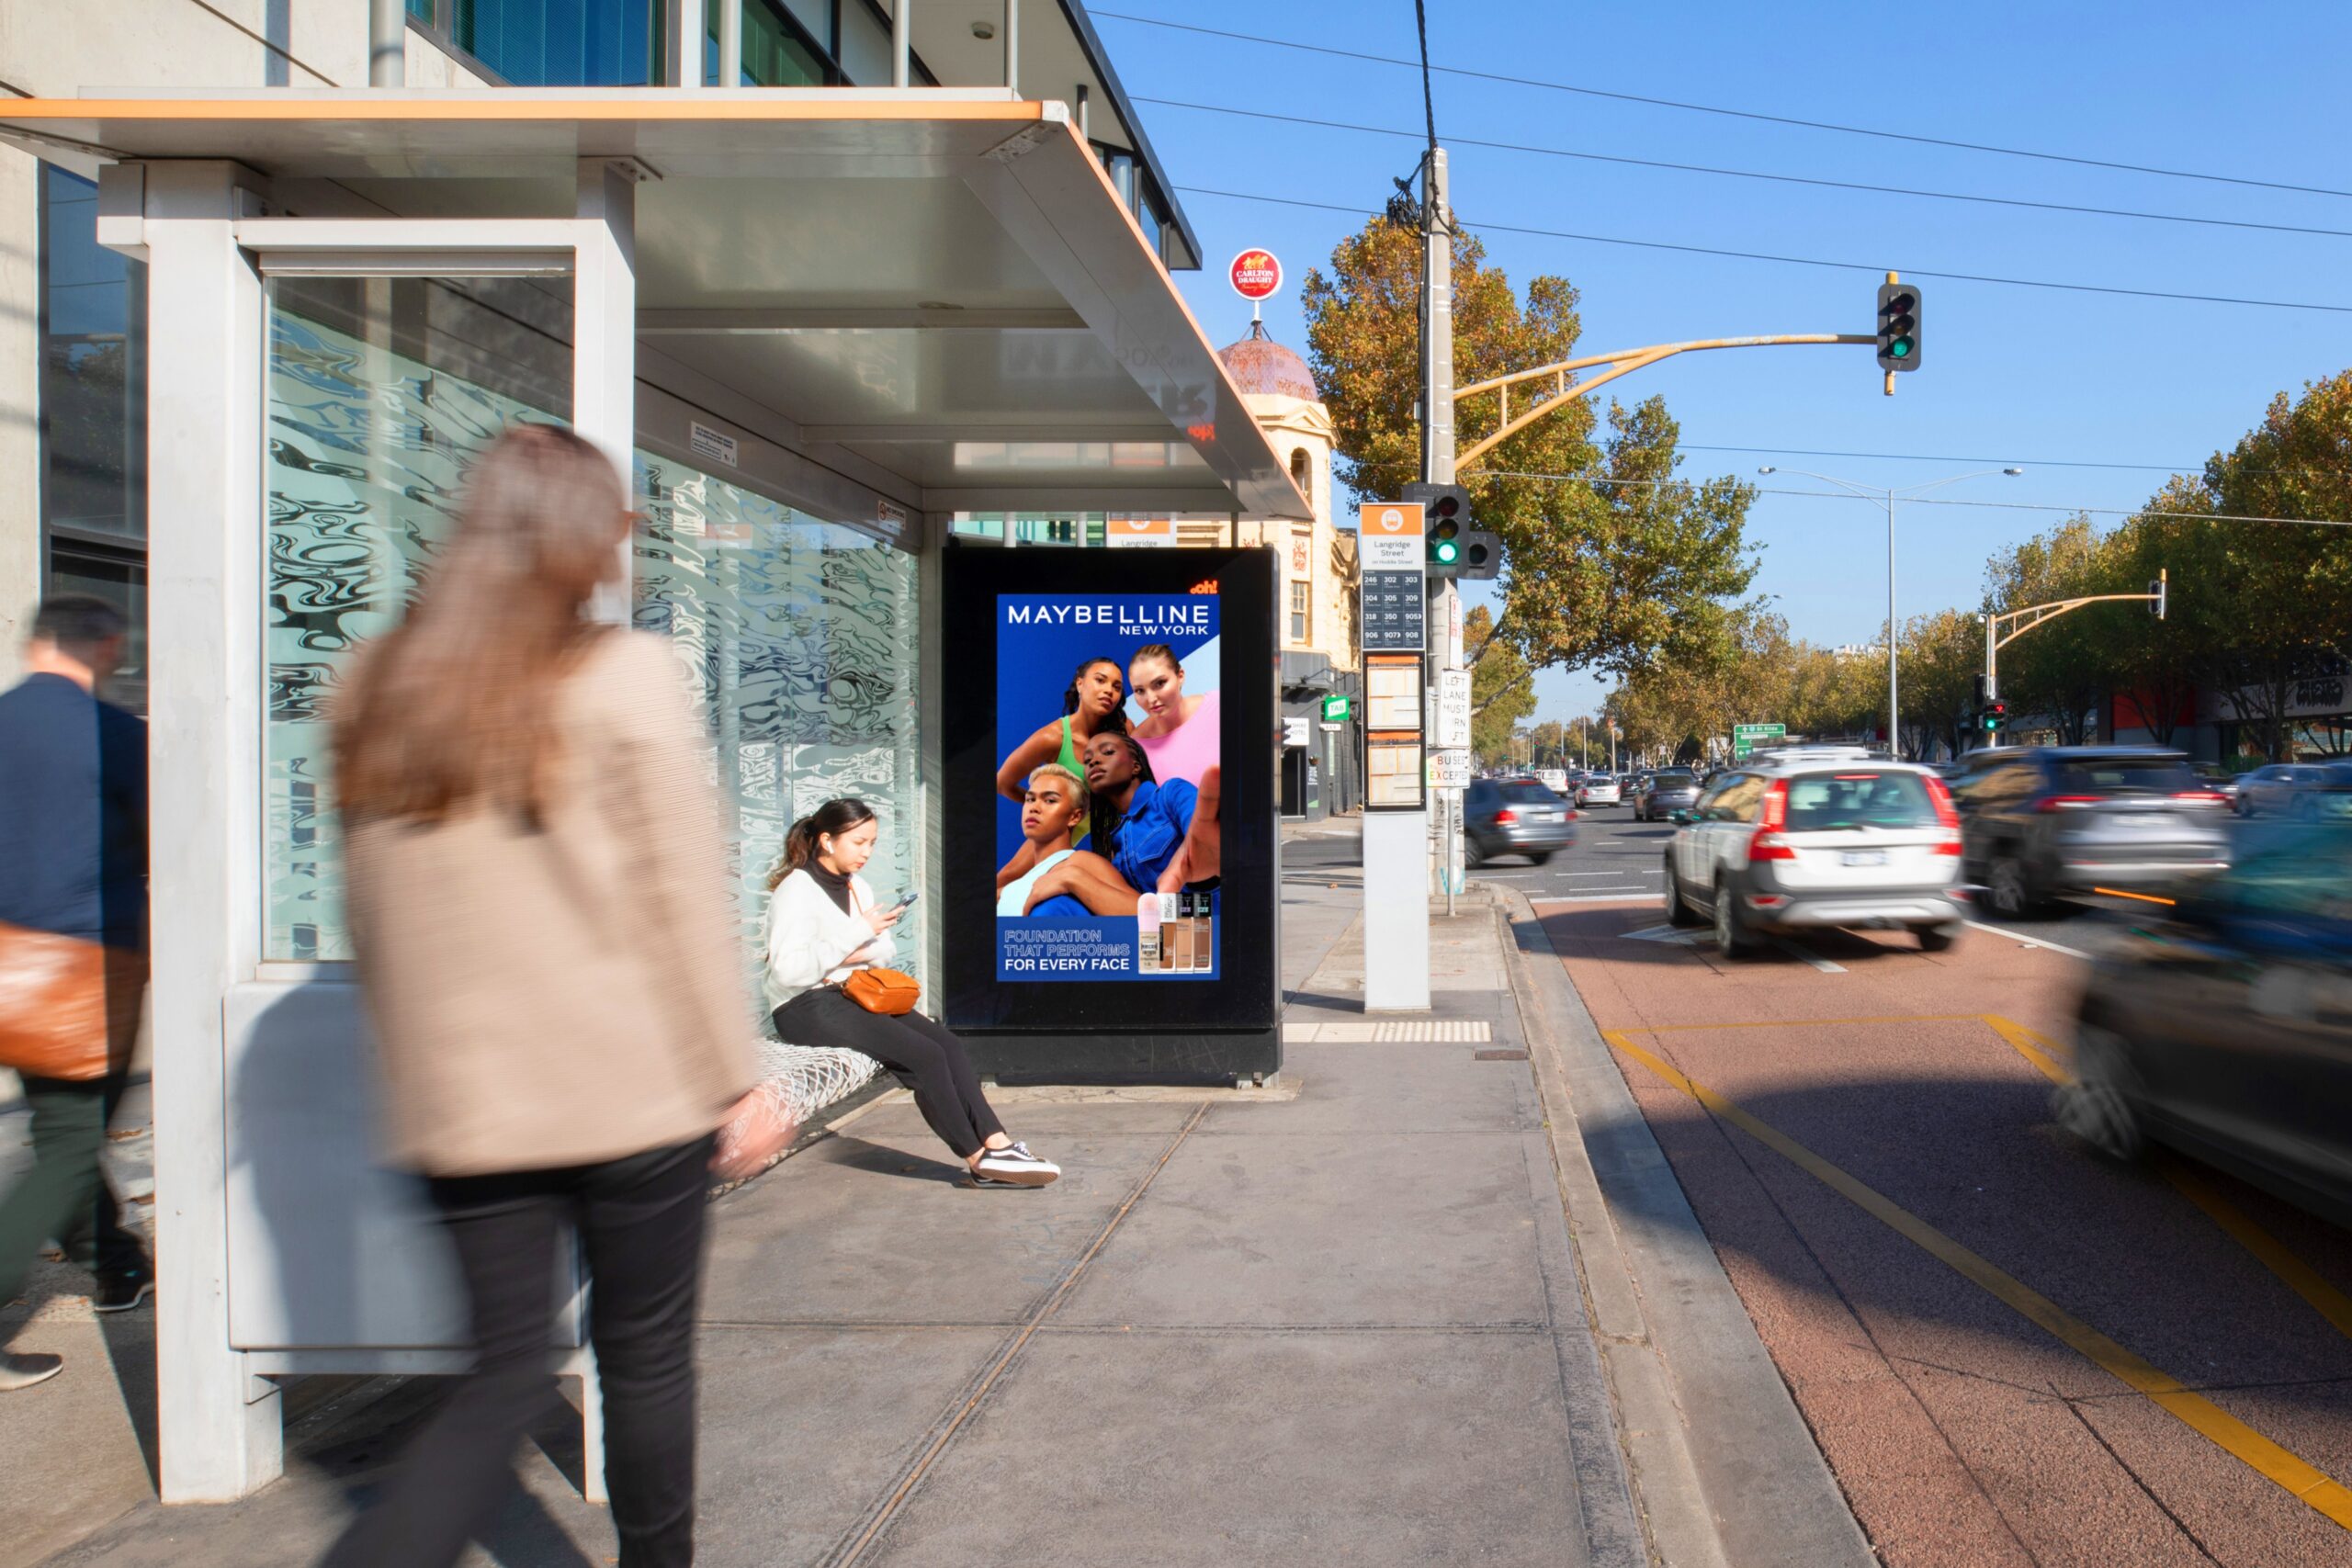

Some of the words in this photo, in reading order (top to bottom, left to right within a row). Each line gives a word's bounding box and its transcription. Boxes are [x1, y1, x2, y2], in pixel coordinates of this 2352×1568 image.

[1374, 540, 1411, 549] Langridge
[1008, 605, 1209, 624] MAYBELLINE
[1119, 626, 1158, 635] NEW
[1163, 626, 1209, 635] YORK
[1445, 676, 1465, 686] LEFT
[1443, 691, 1466, 701] LANE
[1443, 705, 1466, 714] MUST
[1438, 756, 1465, 765] BUSES
[1430, 771, 1468, 780] EXCEPTED
[1004, 930, 1102, 942] FOUNDATION
[1004, 944, 1044, 956] THAT
[1046, 943, 1130, 956] PERFORMS
[1005, 959, 1035, 970] FOR
[1039, 959, 1088, 970] EVERY
[1091, 958, 1130, 970] FACE
